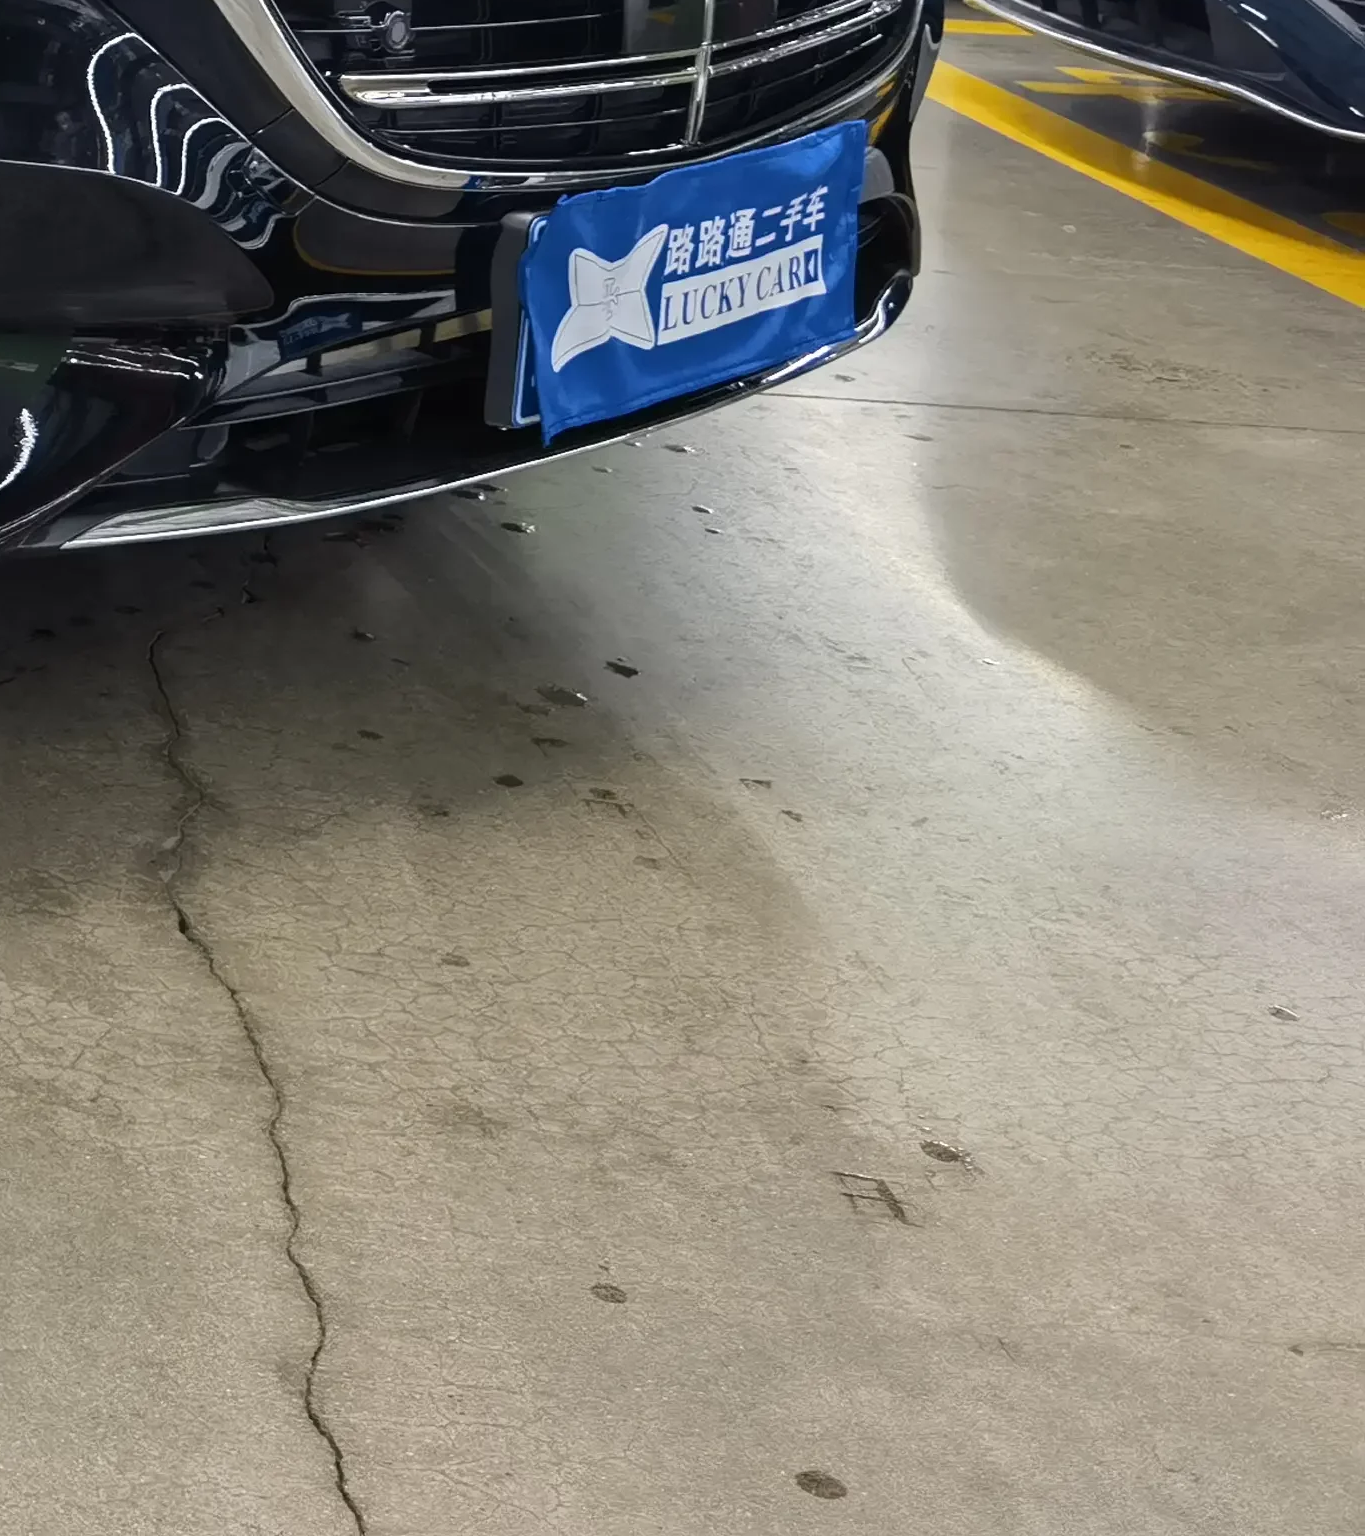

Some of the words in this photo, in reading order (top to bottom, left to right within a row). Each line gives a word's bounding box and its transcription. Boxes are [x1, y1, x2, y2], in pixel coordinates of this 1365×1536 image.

[663, 185, 829, 277] 路路通二手车
[661, 271, 753, 332] LUCKY
[756, 255, 803, 302] CAR
